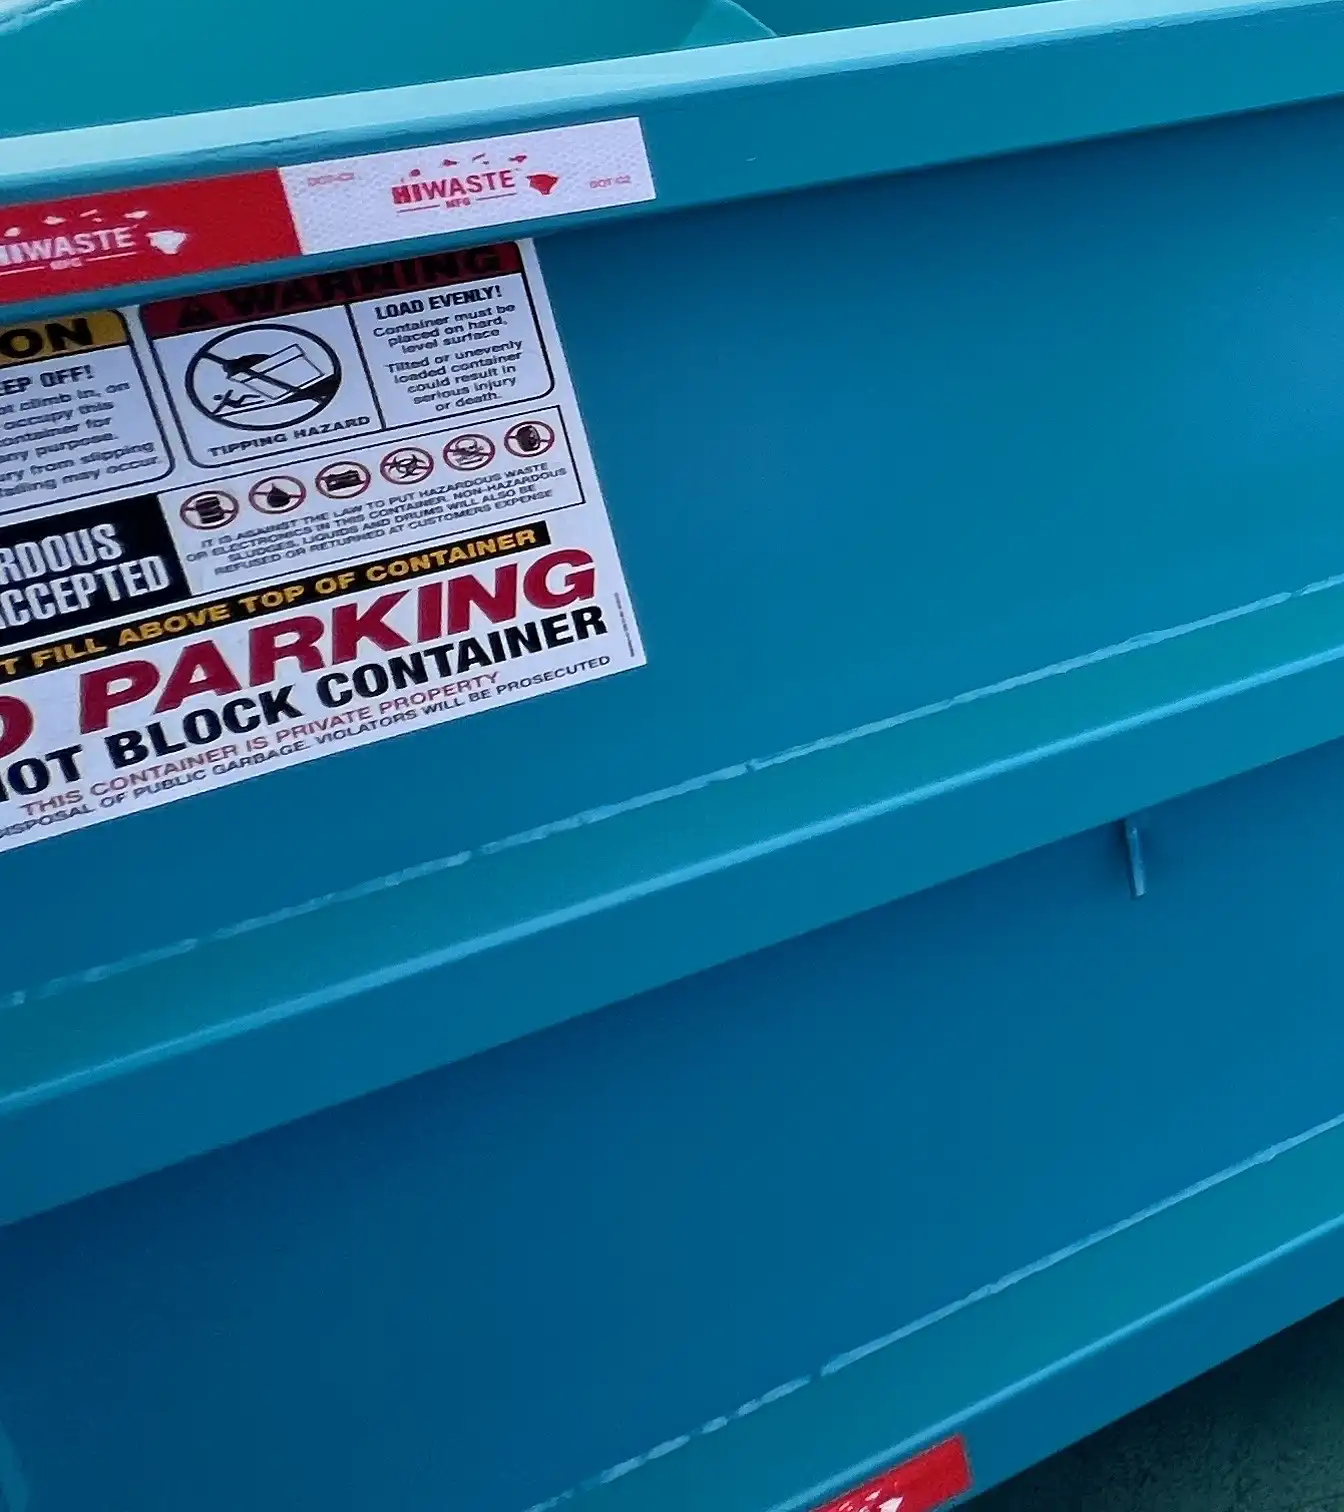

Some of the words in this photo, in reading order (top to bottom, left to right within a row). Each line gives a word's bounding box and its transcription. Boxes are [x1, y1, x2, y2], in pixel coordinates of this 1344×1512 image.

[391, 168, 516, 206] HIWASTE
[229, 244, 501, 316] WARNING
[375, 299, 424, 320] LOAD
[429, 285, 502, 310] EVENLY!
[373, 315, 449, 337] Container
[454, 307, 492, 323] must
[497, 303, 515, 314] be
[388, 328, 439, 348] placed
[444, 324, 464, 335] on
[386, 356, 429, 374] Tilted
[435, 354, 450, 365] or
[455, 339, 523, 360] unevenly
[402, 338, 438, 355] level
[443, 328, 499, 346] surface
[40, 364, 94, 388] OFF!
[394, 365, 446, 384] loaded
[451, 351, 522, 373] container
[407, 377, 450, 393] could
[455, 367, 498, 384] result
[502, 364, 516, 374] in
[413, 387, 469, 405] serious
[473, 376, 516, 392] injury
[435, 401, 451, 412] or
[208, 430, 287, 458] TIPPING
[294, 415, 370, 441] HAZARD
[453, 467, 568, 500] NON-HAZARDOUS
[201, 537, 213, 548] IT
[219, 535, 232, 545] IS
[303, 511, 329, 524] THE
[366, 499, 386, 510] TO
[388, 492, 415, 505] PUT
[419, 472, 502, 499] HAZARDOUS
[504, 462, 548, 479] WASTE
[394, 505, 443, 522] DRUMS
[446, 498, 480, 511] WILL
[482, 490, 515, 503] ALSO
[388, 524, 404, 535] AT
[31, 638, 107, 673] FILL
[119, 603, 232, 647] ABOVE
[239, 585, 305, 615] TOP
[315, 572, 356, 595] OF
[366, 528, 537, 583] CONTAINER
[80, 548, 597, 736] PARKING
[104, 684, 305, 770] BLOCK
[317, 604, 608, 709] CONTAINER
[18, 788, 84, 816] THIS
[91, 743, 239, 799] CONTAINER
[246, 735, 270, 754] IS
[276, 706, 372, 742] PRIVATE
[380, 670, 501, 716] PROPERTY
[100, 792, 125, 809] OF
[132, 768, 207, 801] PUBLIC
[314, 707, 417, 747] VIOLATORS
[420, 697, 469, 717] WILL
[470, 687, 493, 704] BE
[496, 654, 611, 695] PROSECUTED
